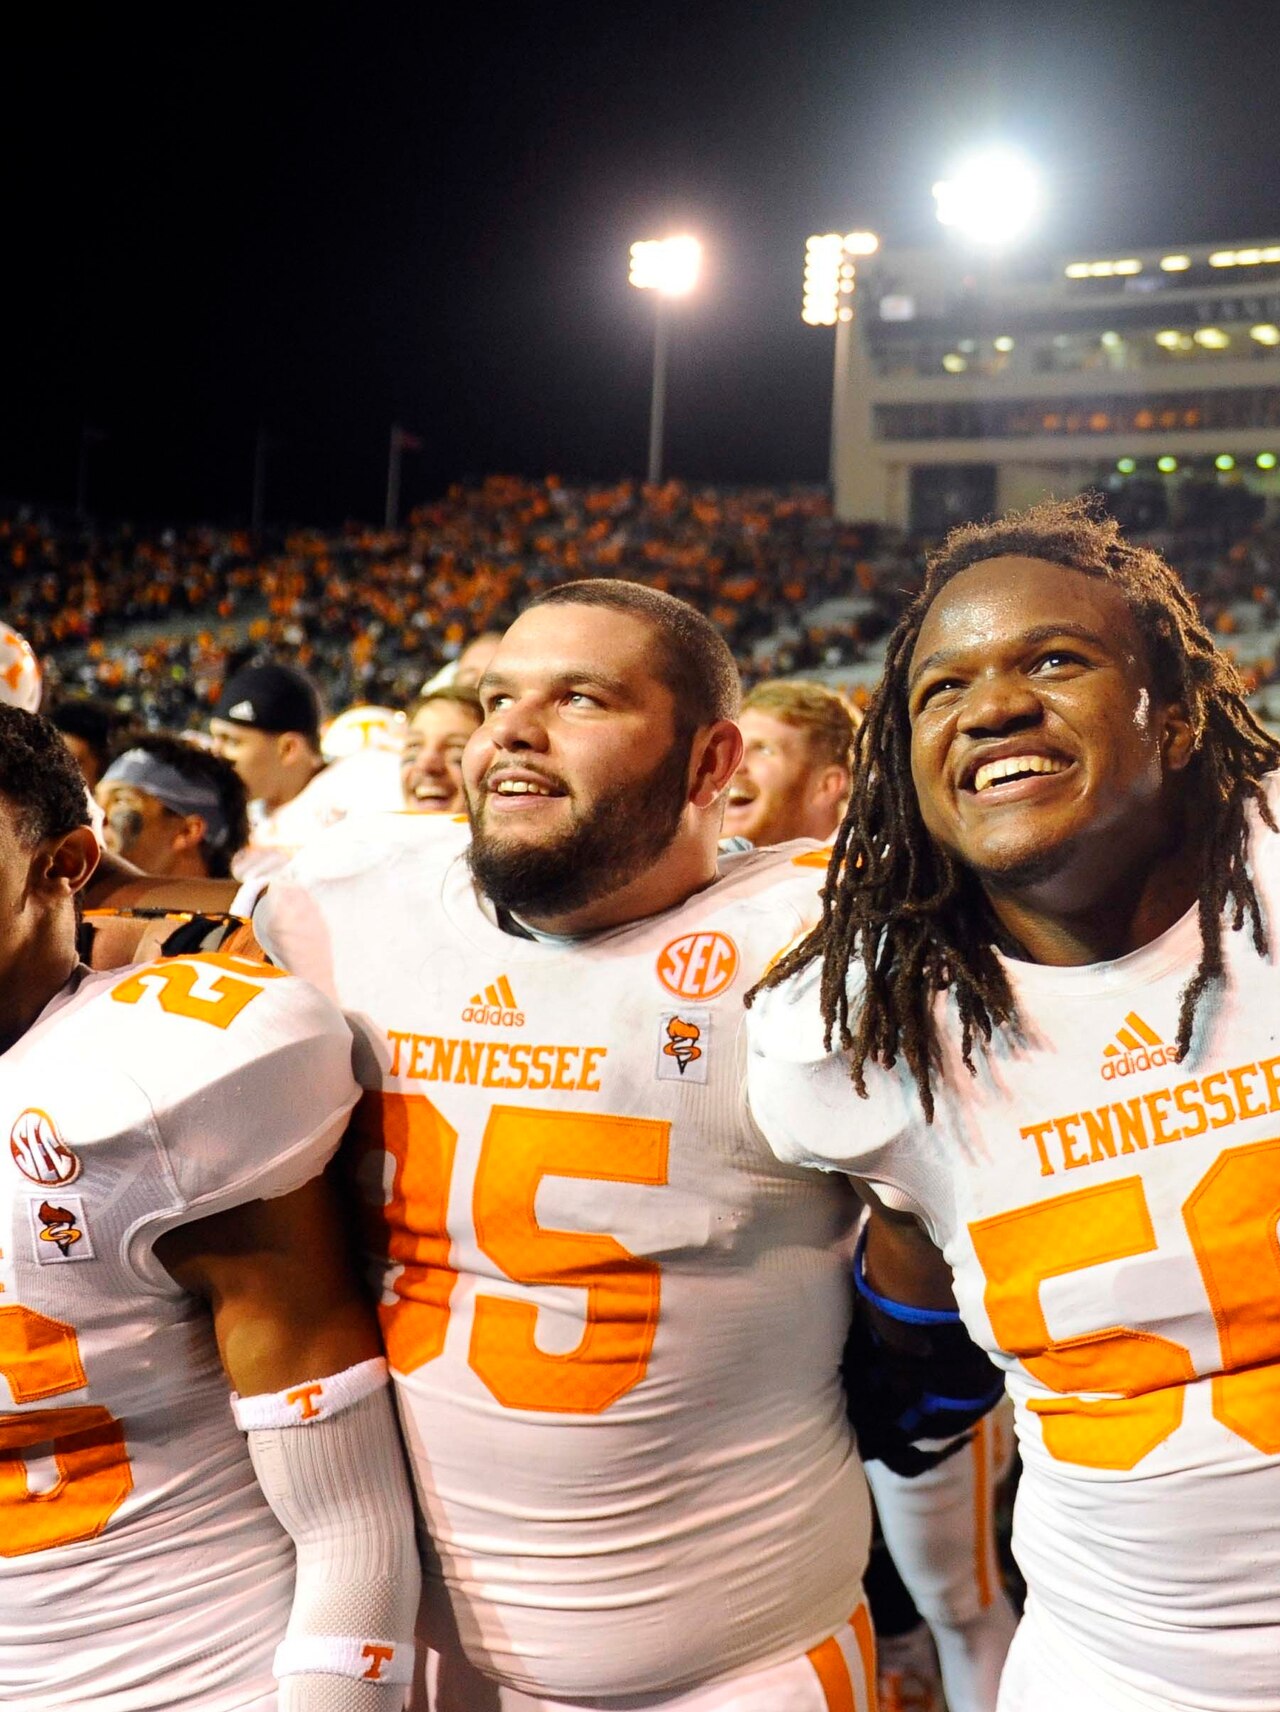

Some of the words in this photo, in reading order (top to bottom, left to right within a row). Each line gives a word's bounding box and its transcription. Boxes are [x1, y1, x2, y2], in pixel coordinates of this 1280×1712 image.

[661, 934, 732, 995] SEC
[461, 1003, 526, 1028] adidas
[386, 1029, 608, 1093] TENNESSEE
[1100, 1042, 1179, 1081] adidas
[286, 1383, 324, 1420] T
[361, 1642, 394, 1680] T
